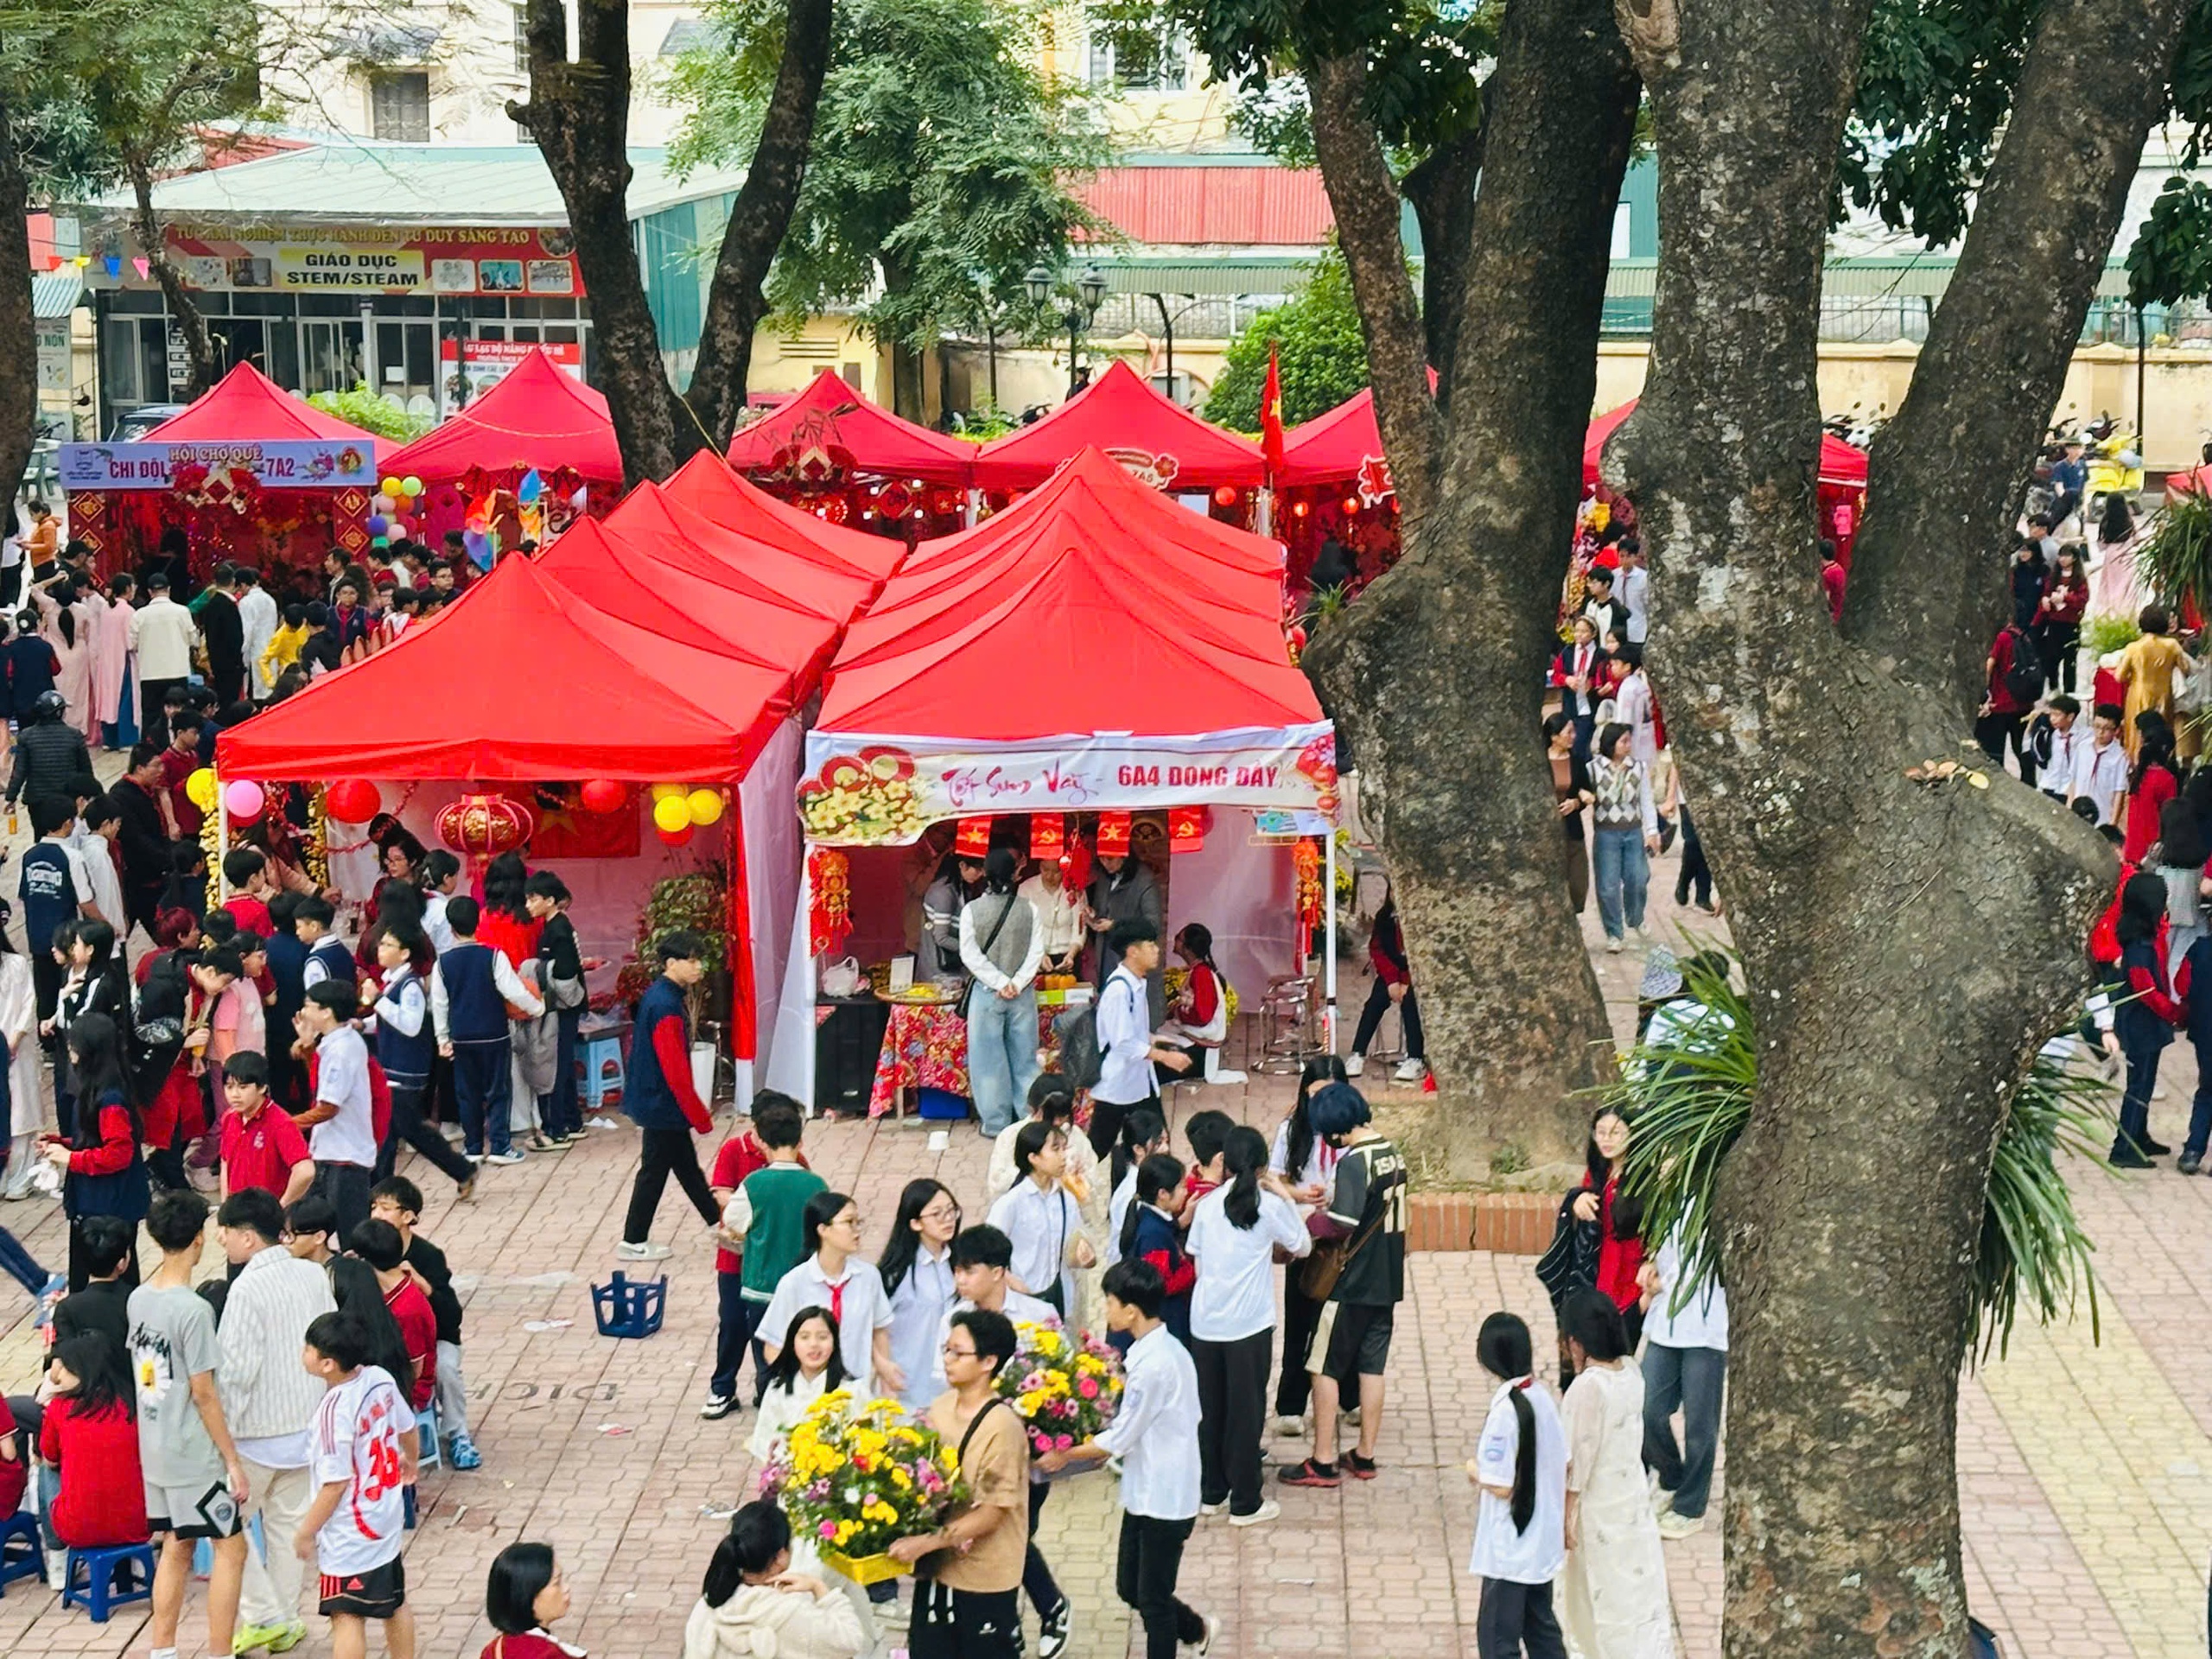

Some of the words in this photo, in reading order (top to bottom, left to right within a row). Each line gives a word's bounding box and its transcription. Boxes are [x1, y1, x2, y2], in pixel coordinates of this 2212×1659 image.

[426, 228, 454, 243] DUY
[459, 226, 497, 244] SÁNG
[500, 229, 530, 247] TẠO
[306, 251, 351, 266] GIÁO
[358, 254, 397, 270] DỤC
[287, 271, 418, 285] STEM/STEAM
[168, 443, 196, 465] HỘI
[199, 445, 229, 464] CHỢ
[232, 442, 263, 464] QUÊ
[110, 461, 134, 479] CHI
[139, 457, 165, 482] ĐỘI
[265, 458, 295, 477] 7A2
[1118, 766, 1160, 785] 6A4
